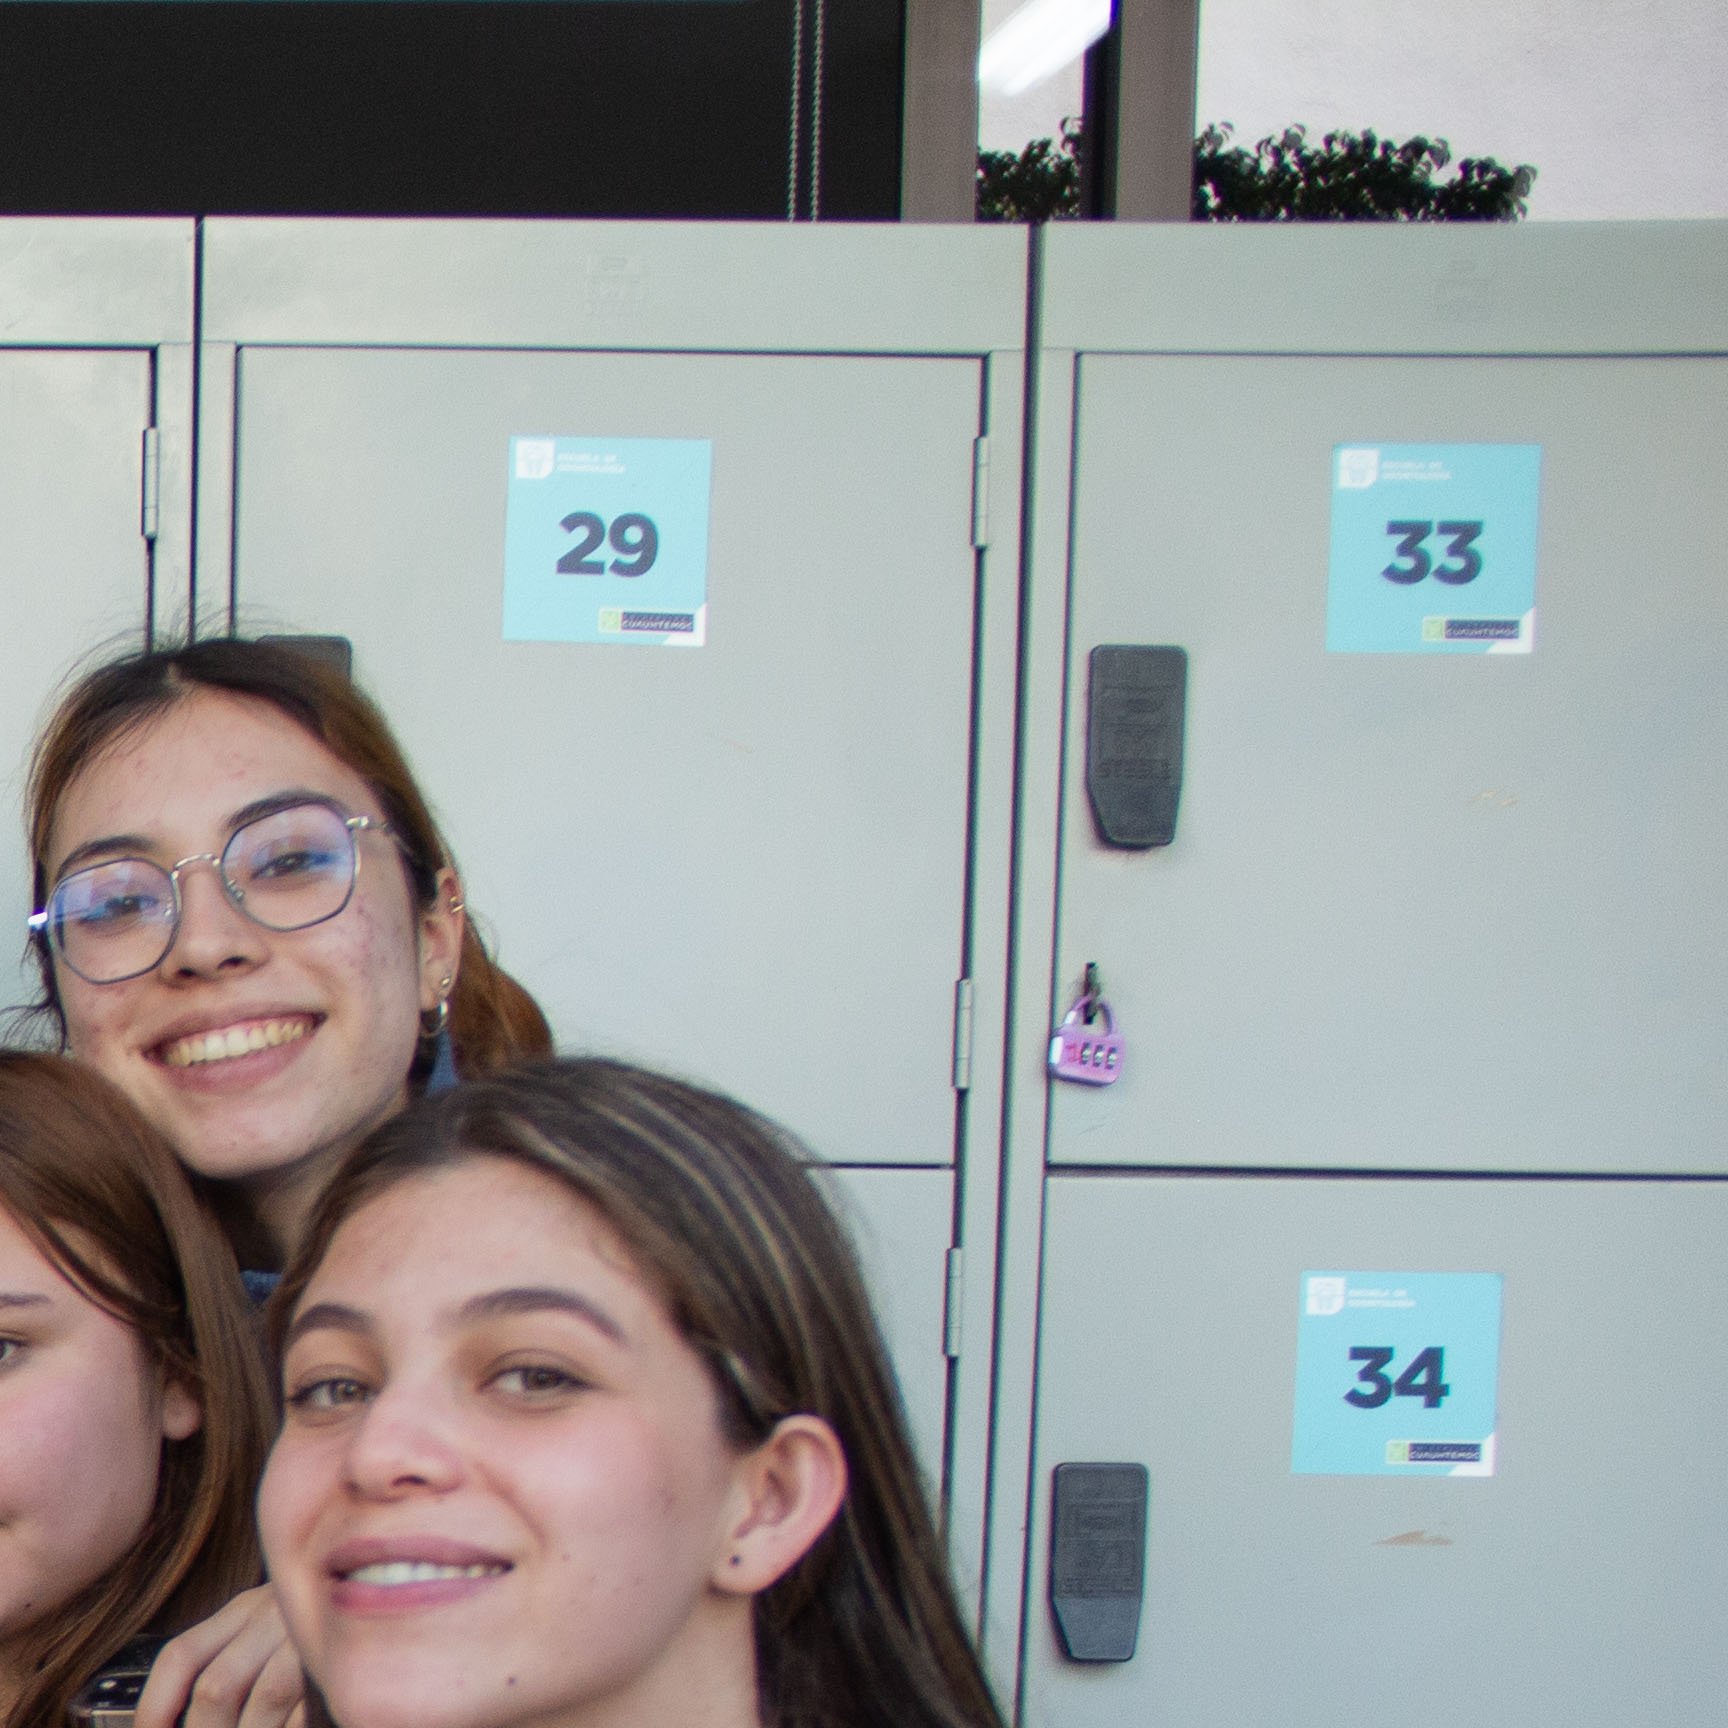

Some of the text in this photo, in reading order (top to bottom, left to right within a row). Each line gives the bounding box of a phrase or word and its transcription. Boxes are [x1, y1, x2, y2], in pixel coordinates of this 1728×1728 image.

[556, 511, 659, 577] 29
[1381, 519, 1484, 586] 33
[1343, 1346, 1452, 1409] 34
